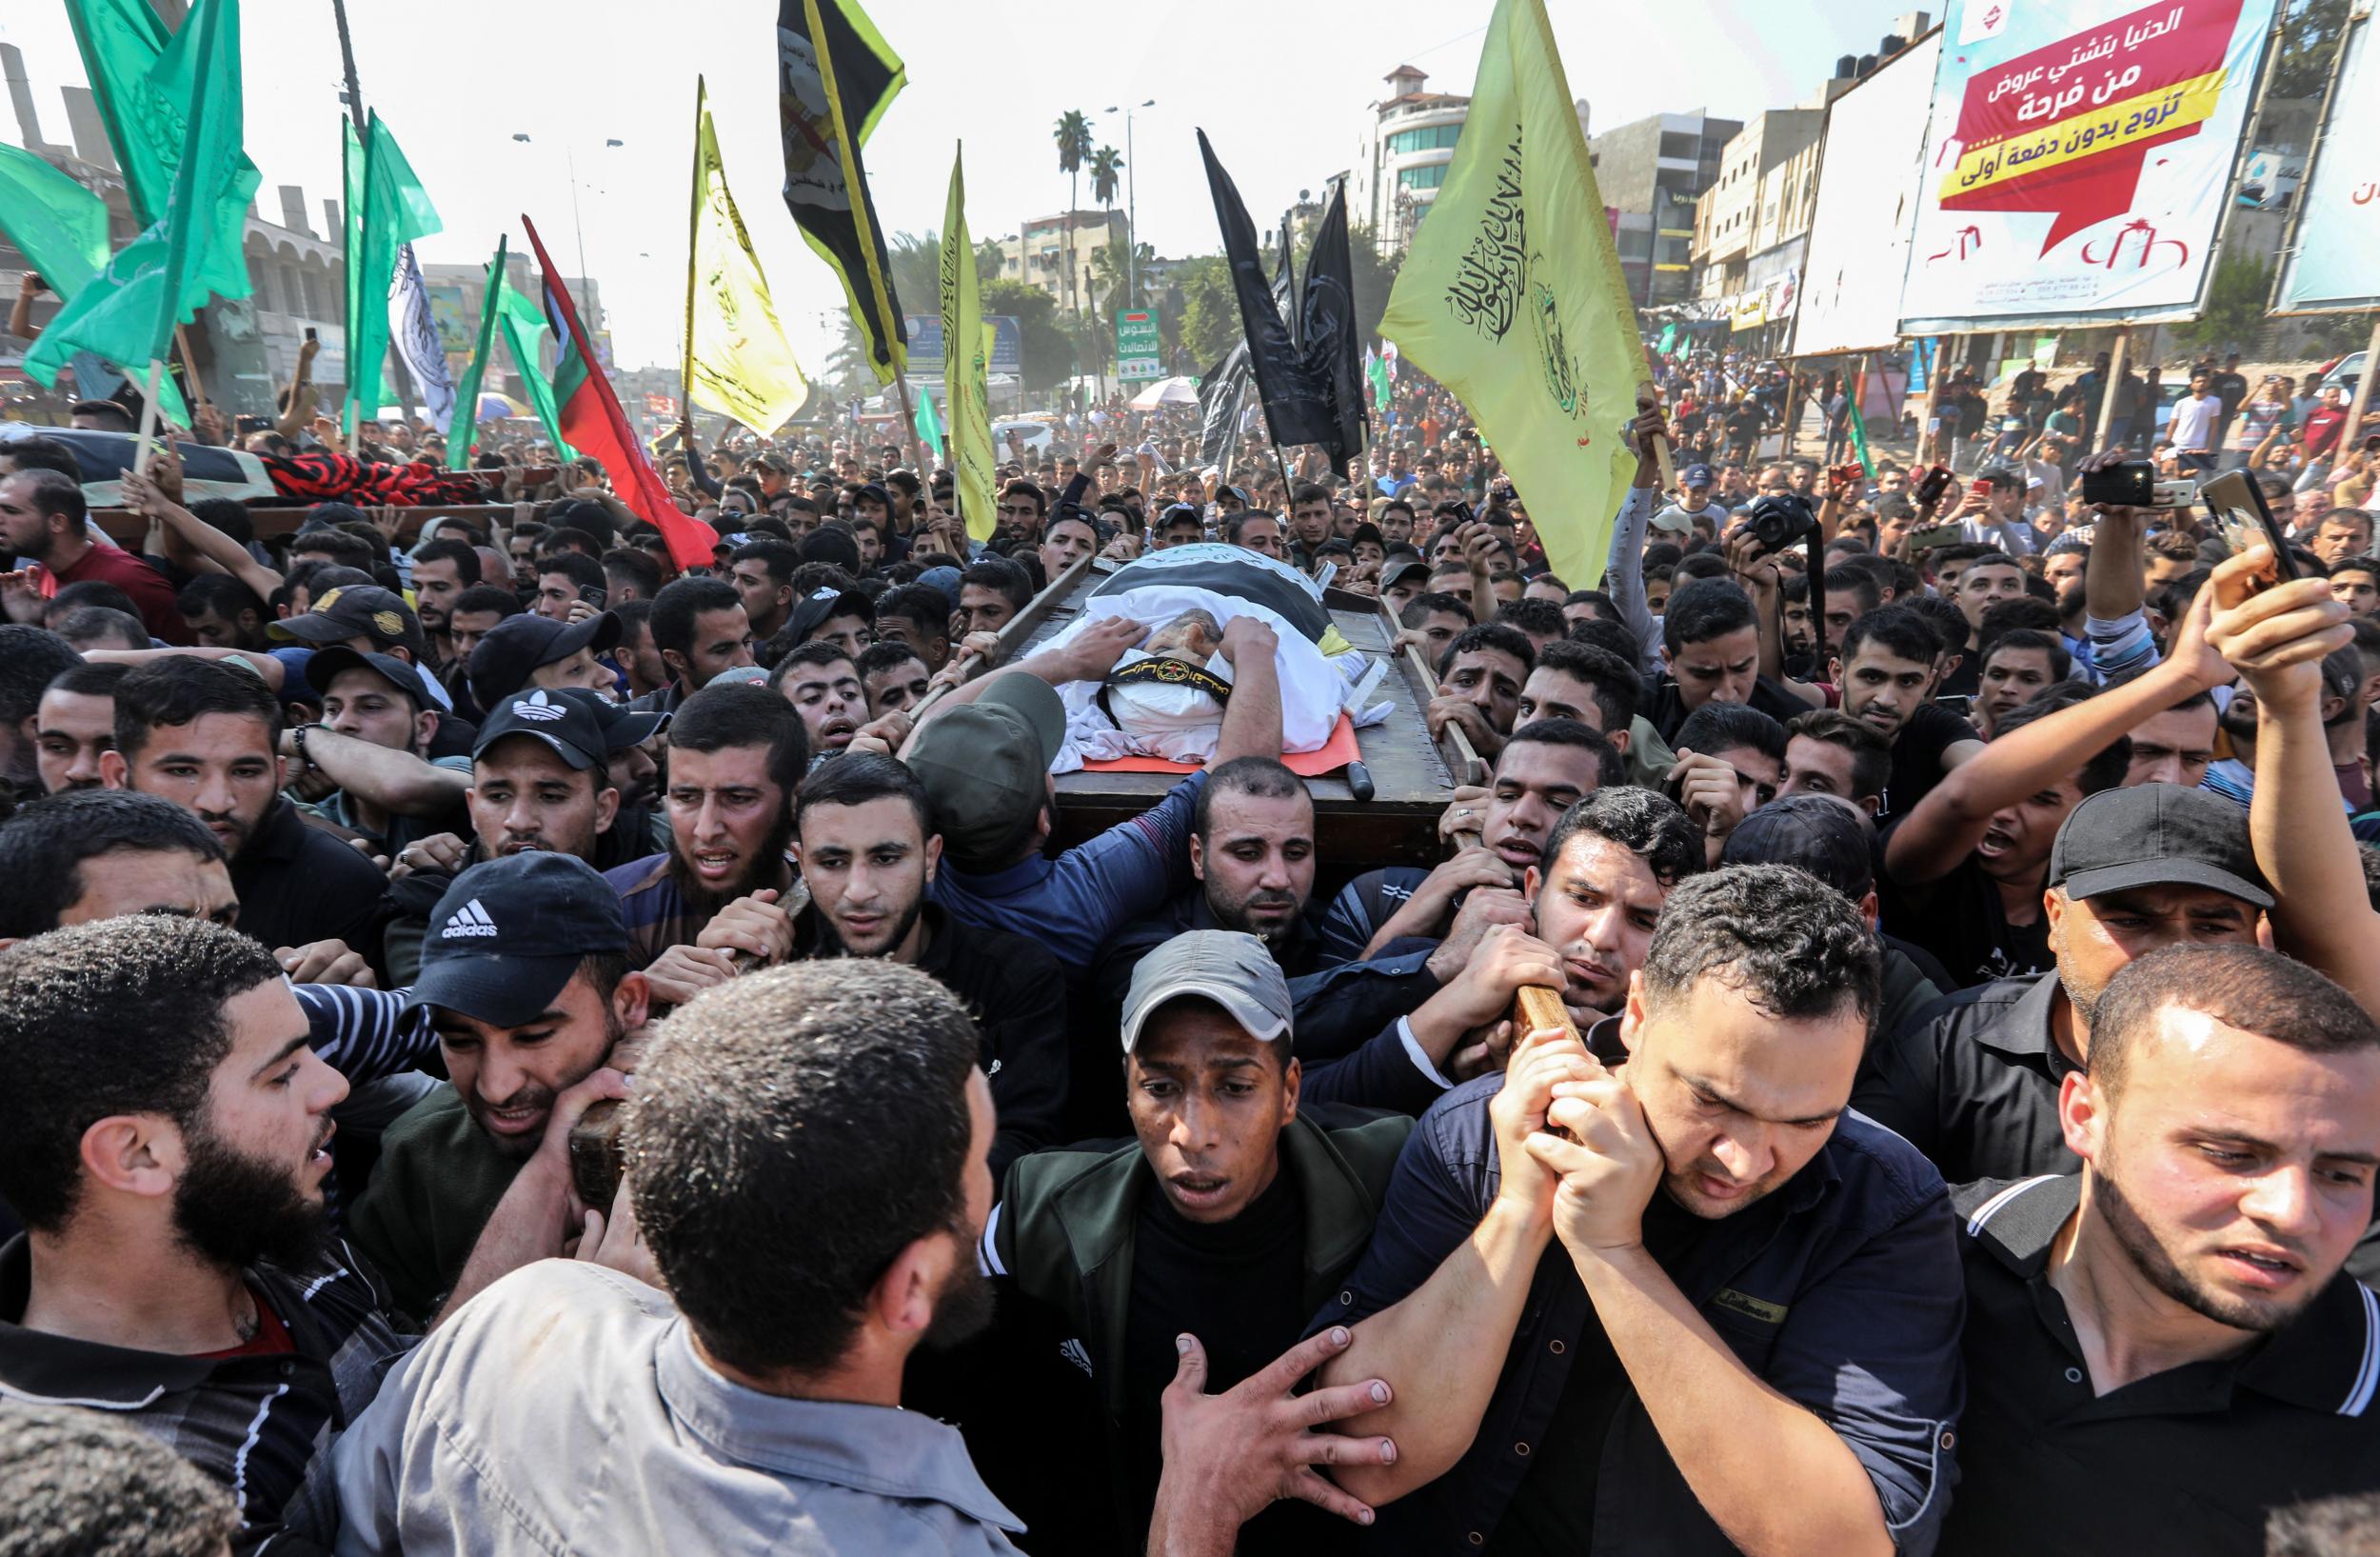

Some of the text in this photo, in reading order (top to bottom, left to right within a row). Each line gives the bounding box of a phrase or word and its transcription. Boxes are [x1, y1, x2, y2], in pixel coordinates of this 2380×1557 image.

[1988, 7, 2184, 103] الدنيا بتشتي عروض
[2017, 78, 2084, 122] فرحة
[2092, 66, 2141, 105] من
[2007, 138, 2058, 167] دفعة
[2065, 119, 2119, 153] بدون
[1961, 143, 2004, 187] أولى
[442, 923, 498, 939] adidas
